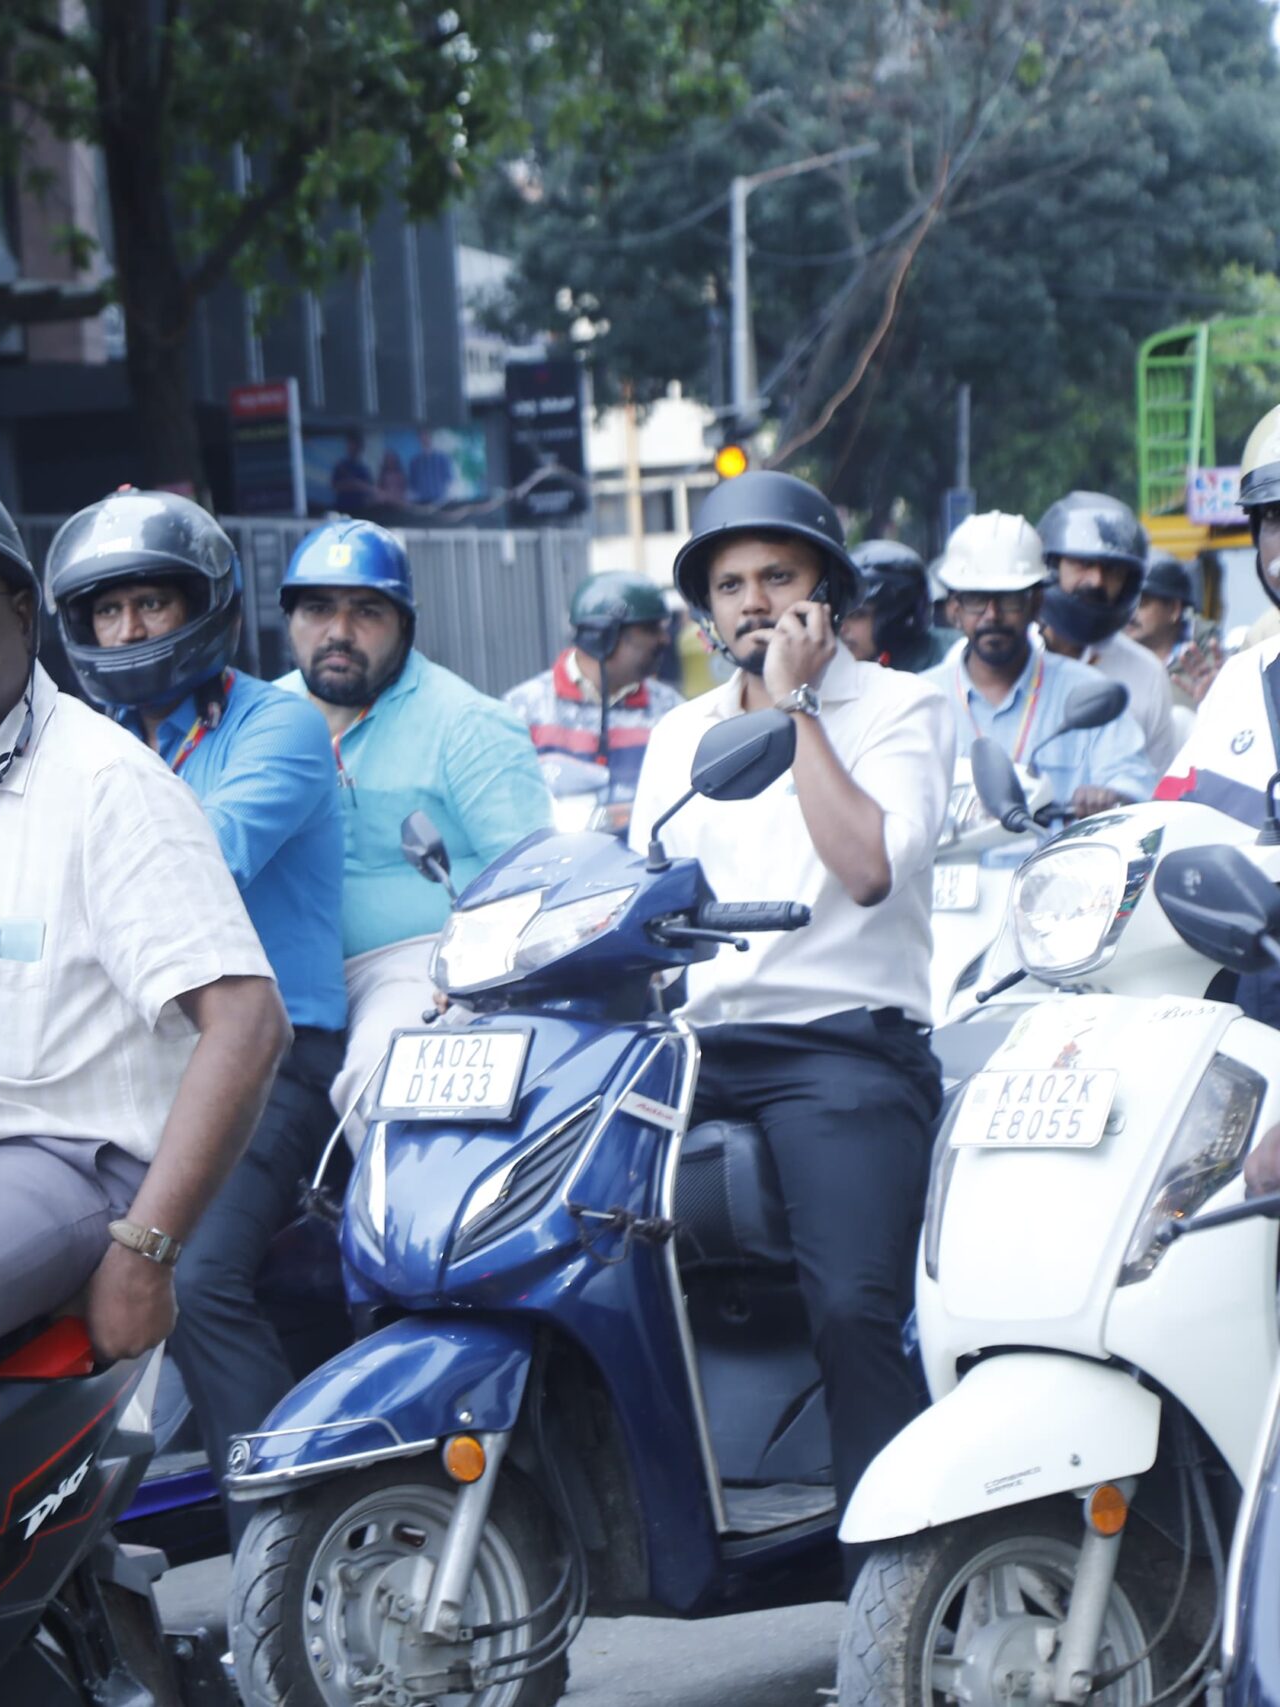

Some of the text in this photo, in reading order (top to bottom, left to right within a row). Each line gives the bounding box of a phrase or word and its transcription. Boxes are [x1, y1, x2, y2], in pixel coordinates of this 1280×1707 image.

[415, 1038, 495, 1070] KA02L
[405, 1072, 492, 1103] D1433
[997, 1074, 1097, 1105] KA02K
[985, 1108, 1084, 1141] E8055
